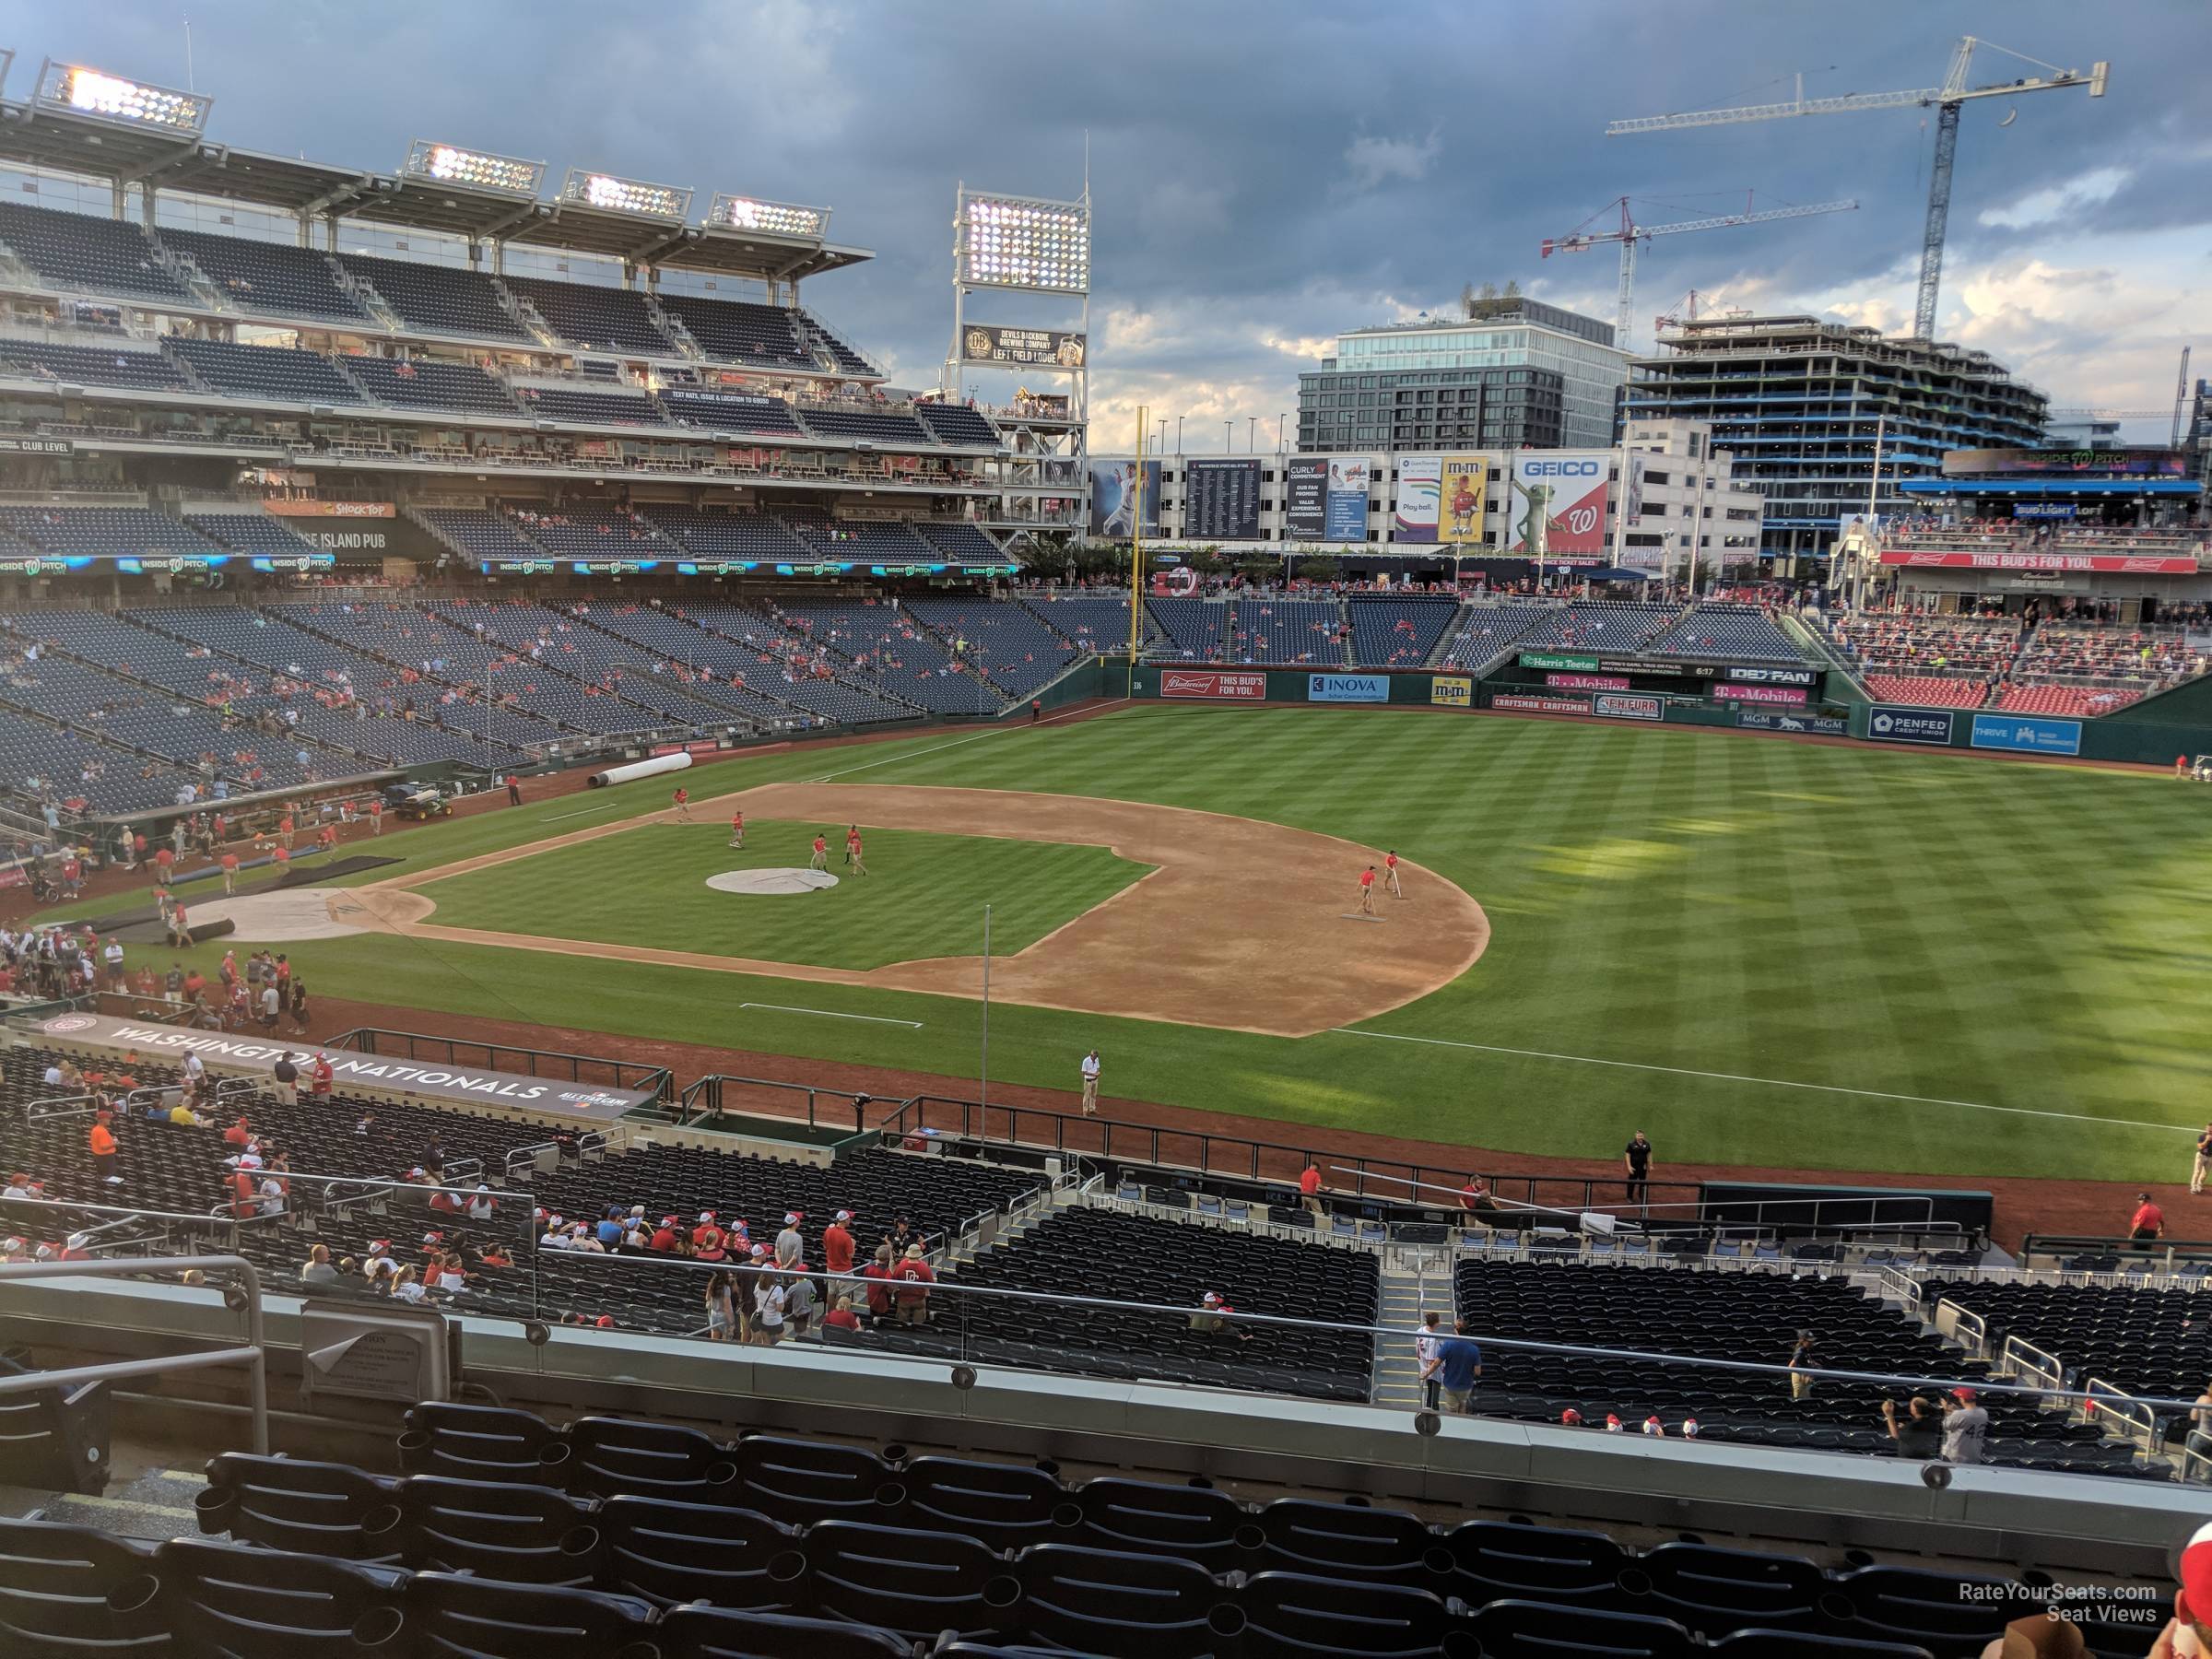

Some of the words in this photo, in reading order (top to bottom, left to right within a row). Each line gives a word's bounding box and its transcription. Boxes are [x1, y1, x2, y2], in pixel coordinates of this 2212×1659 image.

[1001, 330, 1020, 339] DEVILS
[1022, 331, 1049, 341] BACKBONE
[1000, 338, 1024, 347] BREWING
[1026, 339, 1051, 349] COMPANY
[994, 348, 1010, 359] LEFT
[1013, 350, 1032, 361] FIELD
[1034, 352, 1056, 363] LODGE
[22, 441, 42, 450] CLUB
[45, 442, 68, 452] LEVEL
[1524, 462, 1598, 476] GEICO
[335, 503, 367, 514] SHOCK
[368, 504, 385, 516] TOP
[2076, 507, 2102, 515] LOFT
[1569, 506, 1597, 535] W
[321, 534, 360, 547] ISLAND
[363, 534, 385, 547] PUB
[1971, 555, 1998, 566] THIS
[2001, 555, 2037, 567] BUD'S
[2039, 557, 2064, 568] FOR
[2066, 558, 2094, 569] YOU.
[1534, 657, 1563, 667] Harris
[1565, 659, 1596, 669] Teeter
[1170, 678, 1209, 688] Budweiser
[1219, 677, 1238, 686] THIS
[1239, 677, 1264, 686] BUD'S
[1771, 671, 1810, 683] FAN
[1219, 686, 1235, 695] FOR
[1236, 687, 1254, 695] YOU.
[1329, 679, 1376, 691] INOVA
[1495, 699, 1539, 709] CRAFTSMAN
[1543, 700, 1588, 712] CRAFTSMAN
[1743, 714, 1770, 724] MGM
[1814, 720, 1841, 729] MGM
[1895, 718, 1947, 730] PENFED
[1975, 727, 2007, 737] THRIVE
[334, 1060, 549, 1100] NATIONALS
